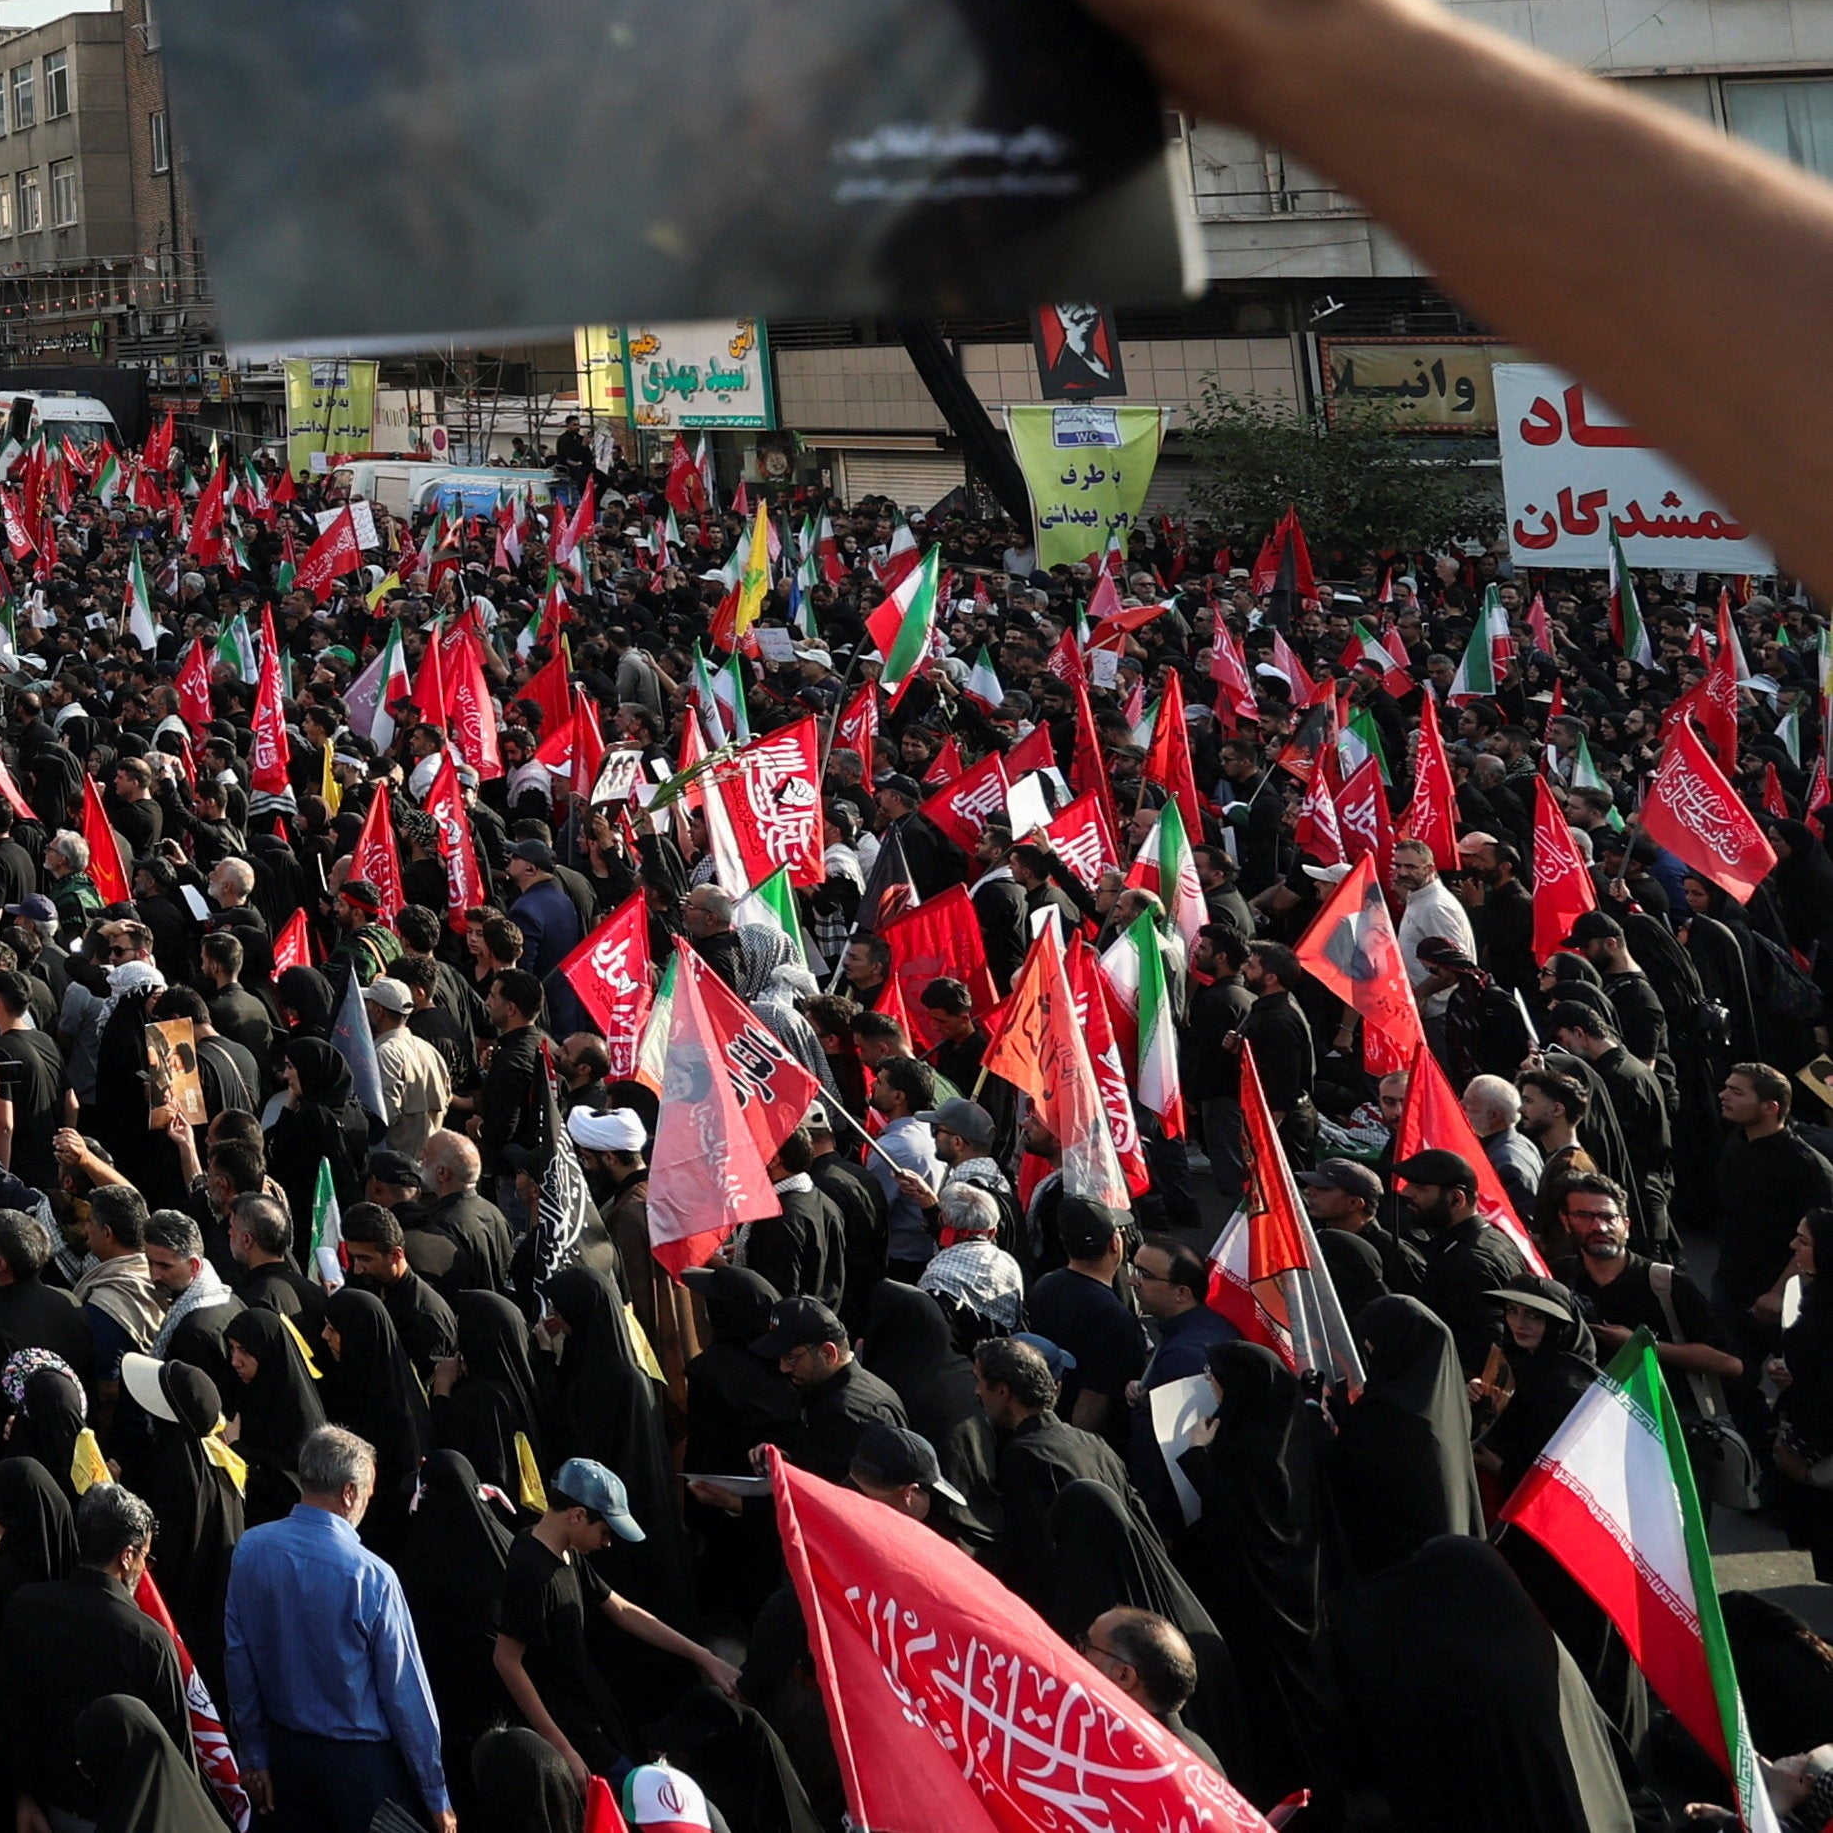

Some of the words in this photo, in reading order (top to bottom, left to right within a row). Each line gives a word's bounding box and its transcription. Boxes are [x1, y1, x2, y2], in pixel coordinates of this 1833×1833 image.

[334, 423, 370, 438] سرویس
[1076, 432, 1099, 442] WC
[1060, 462, 1106, 491] طرف
[1040, 504, 1099, 530] بهداشتی
[1513, 486, 1751, 550] مشدگان
